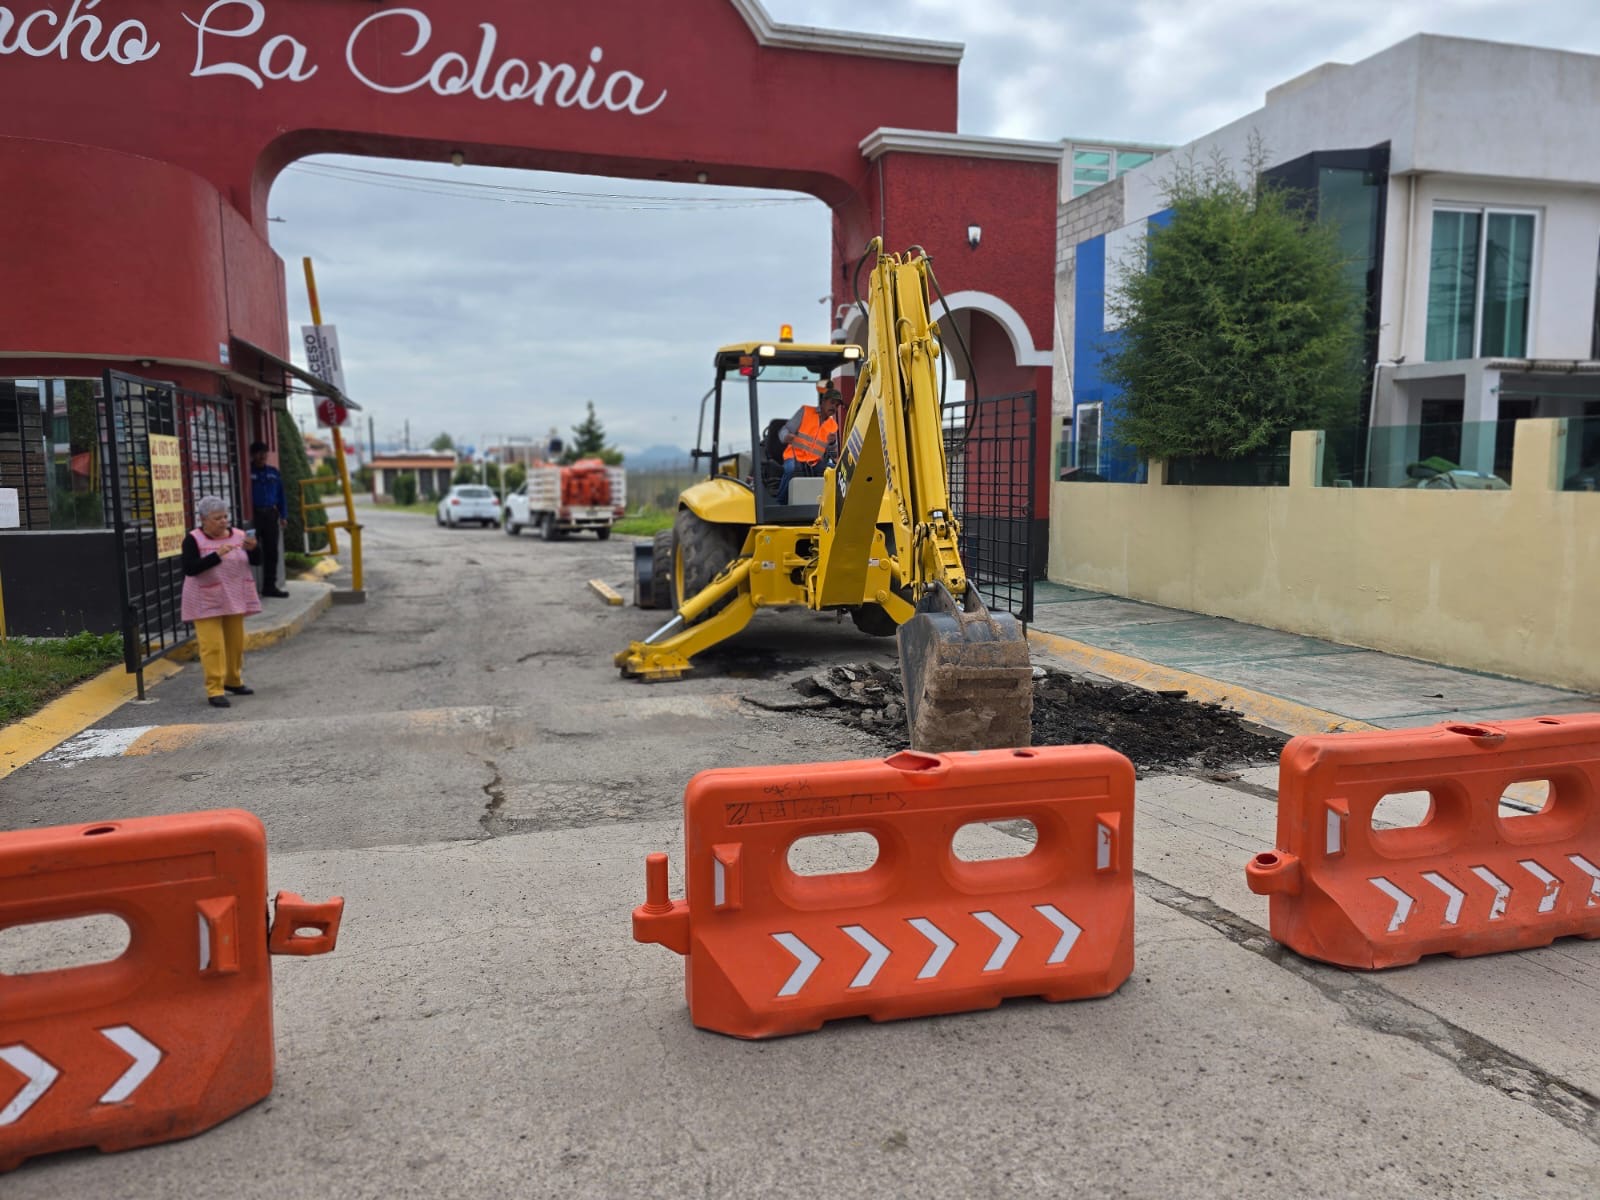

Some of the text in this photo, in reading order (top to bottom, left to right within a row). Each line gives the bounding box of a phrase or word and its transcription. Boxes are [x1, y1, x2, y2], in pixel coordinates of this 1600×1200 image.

[181, 0, 318, 90] La
[345, 7, 668, 116] Colonia
[305, 334, 321, 379] CESO
